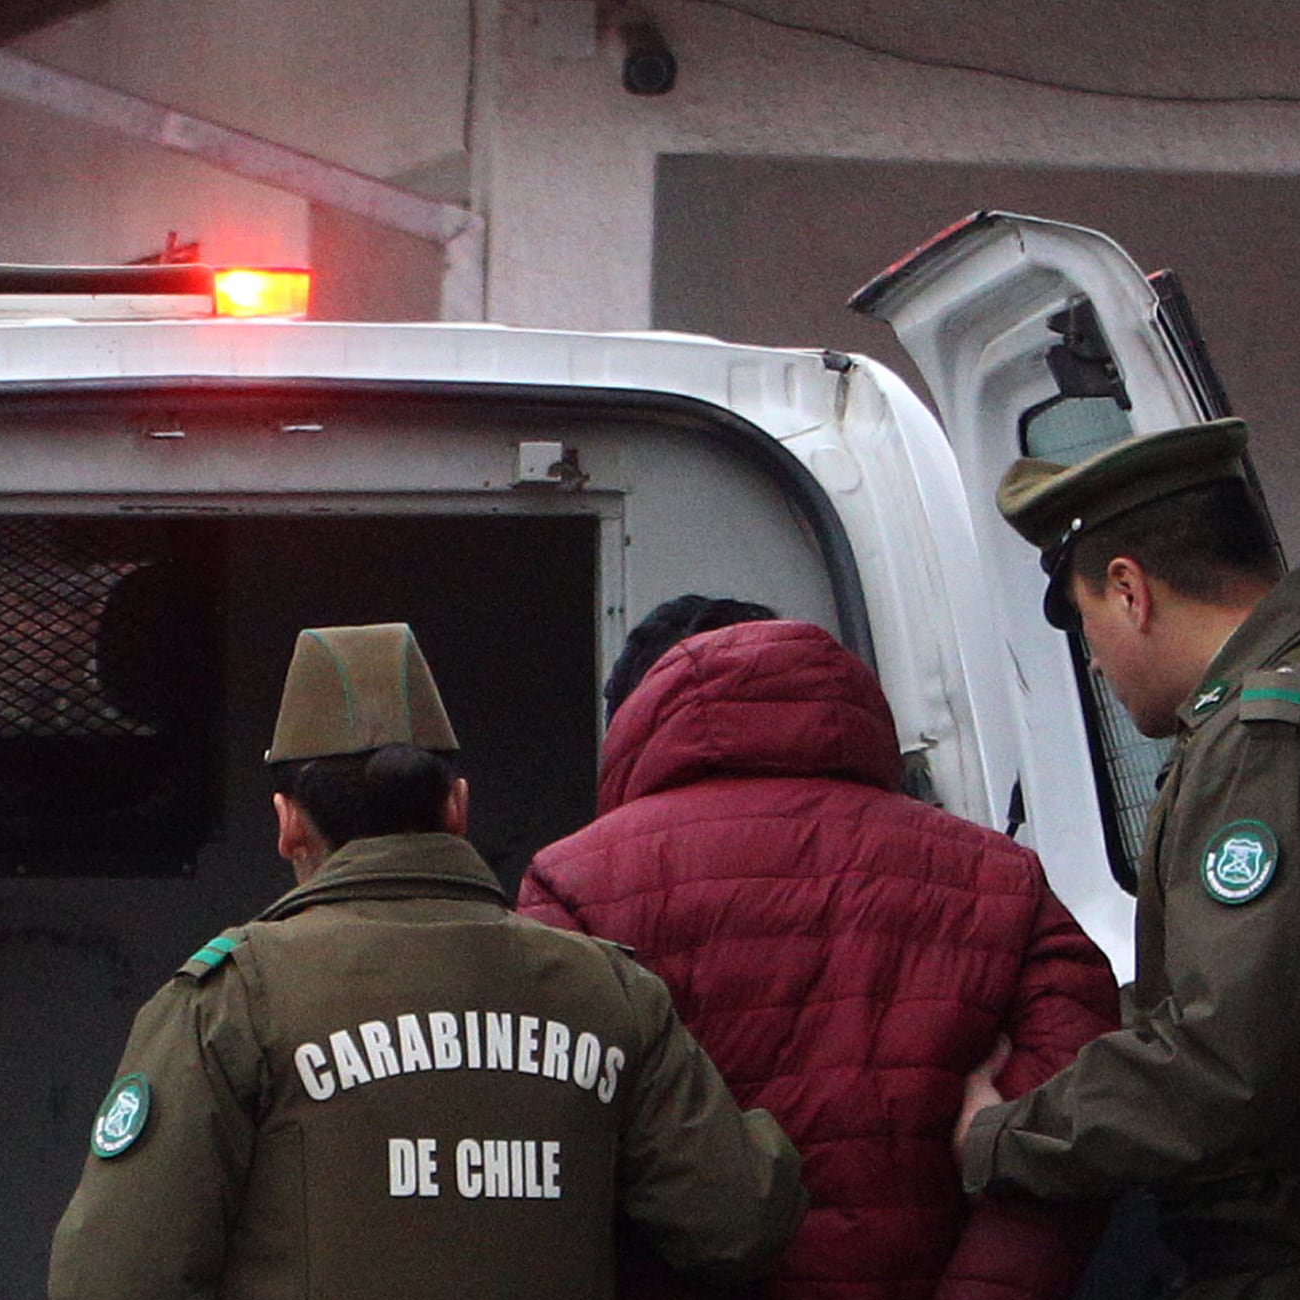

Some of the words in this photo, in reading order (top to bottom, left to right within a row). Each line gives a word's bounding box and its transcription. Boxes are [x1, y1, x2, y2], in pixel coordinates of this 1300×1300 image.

[293, 1010, 626, 1104] CARABINEROS
[388, 1138, 440, 1198] DE
[455, 1138, 561, 1199] CHILE
